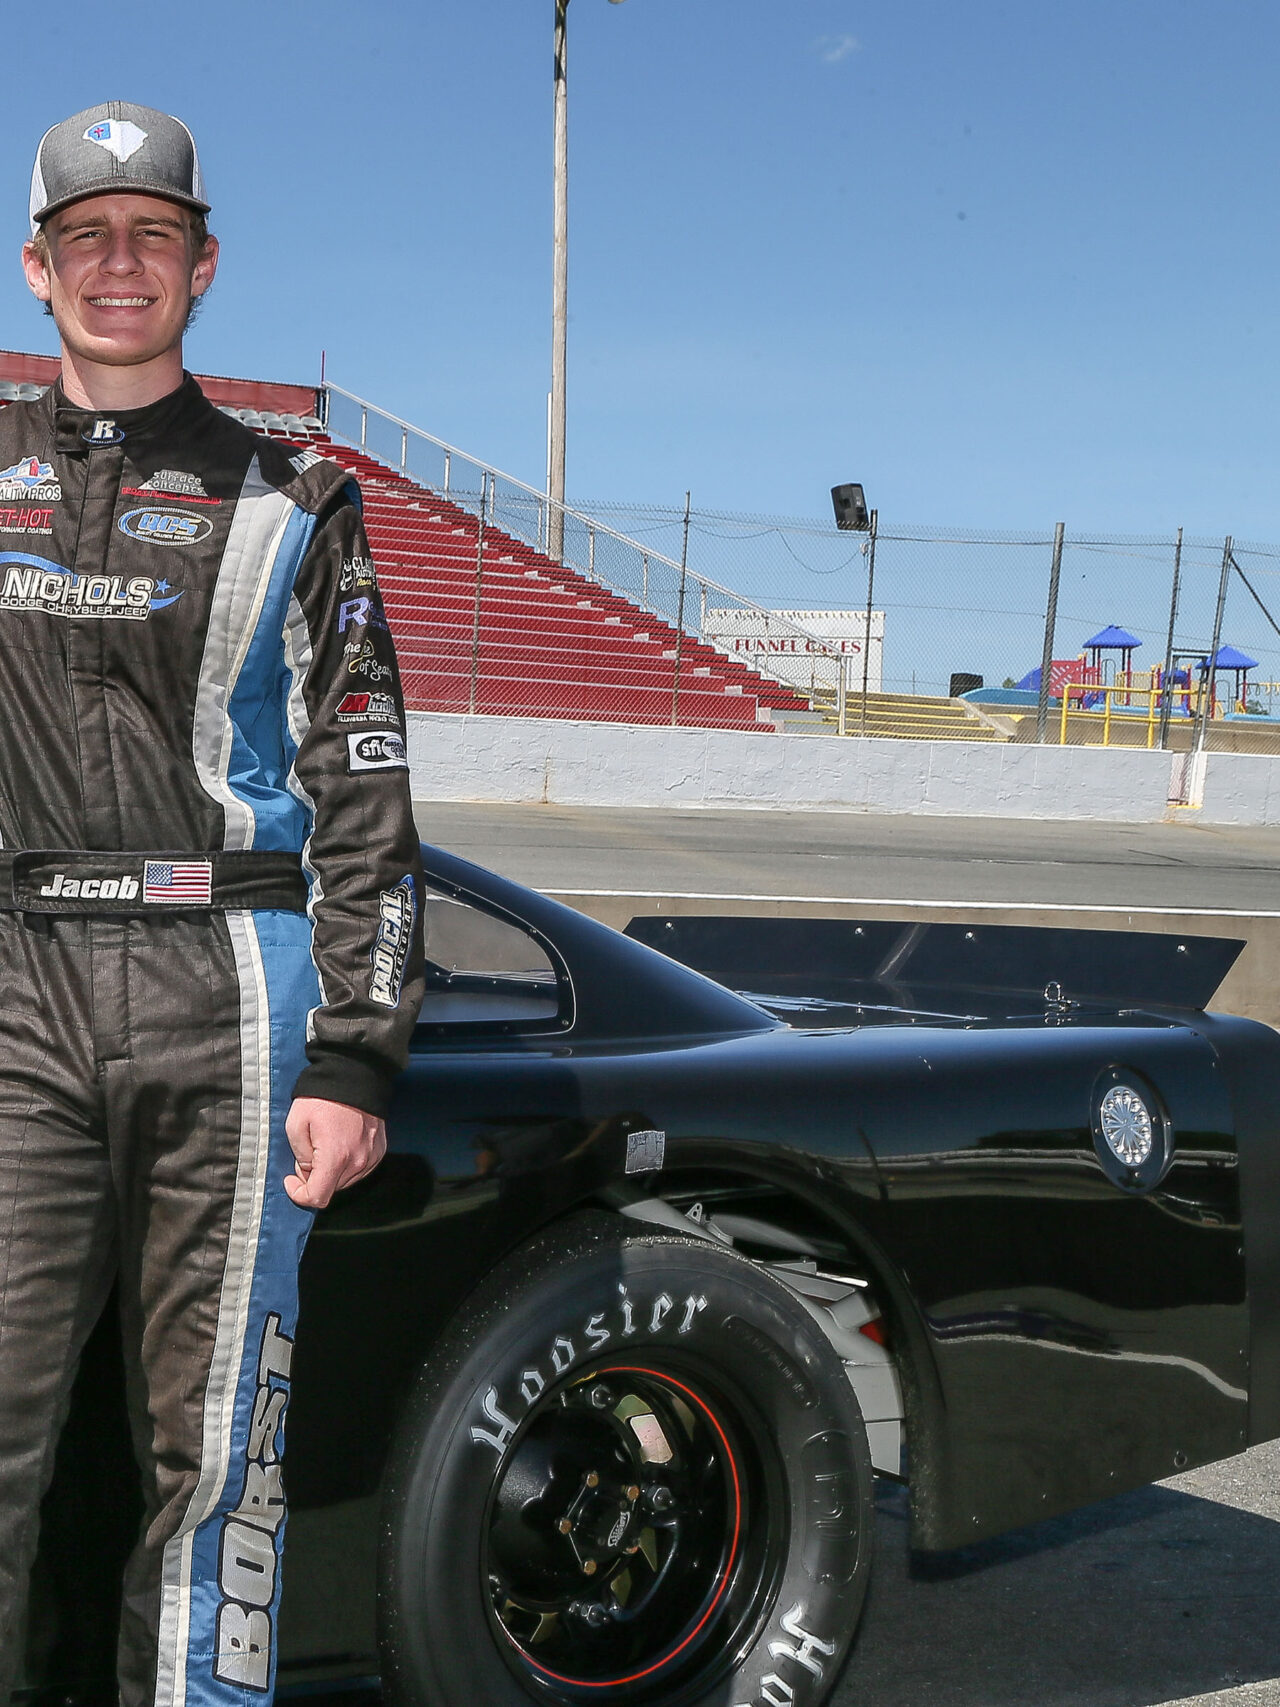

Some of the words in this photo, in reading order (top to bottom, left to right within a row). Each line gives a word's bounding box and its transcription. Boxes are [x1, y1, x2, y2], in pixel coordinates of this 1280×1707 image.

[91, 420, 116, 440] R
[3, 567, 154, 608] NICHOLS
[0, 597, 43, 608] DODGE
[116, 606, 148, 618] JEEP
[735, 639, 799, 652] FUNNEL
[40, 874, 140, 900] Jacob
[369, 890, 405, 1008] RADICAL
[470, 1283, 709, 1459] Hoosier
[213, 1311, 294, 1693] BORST
